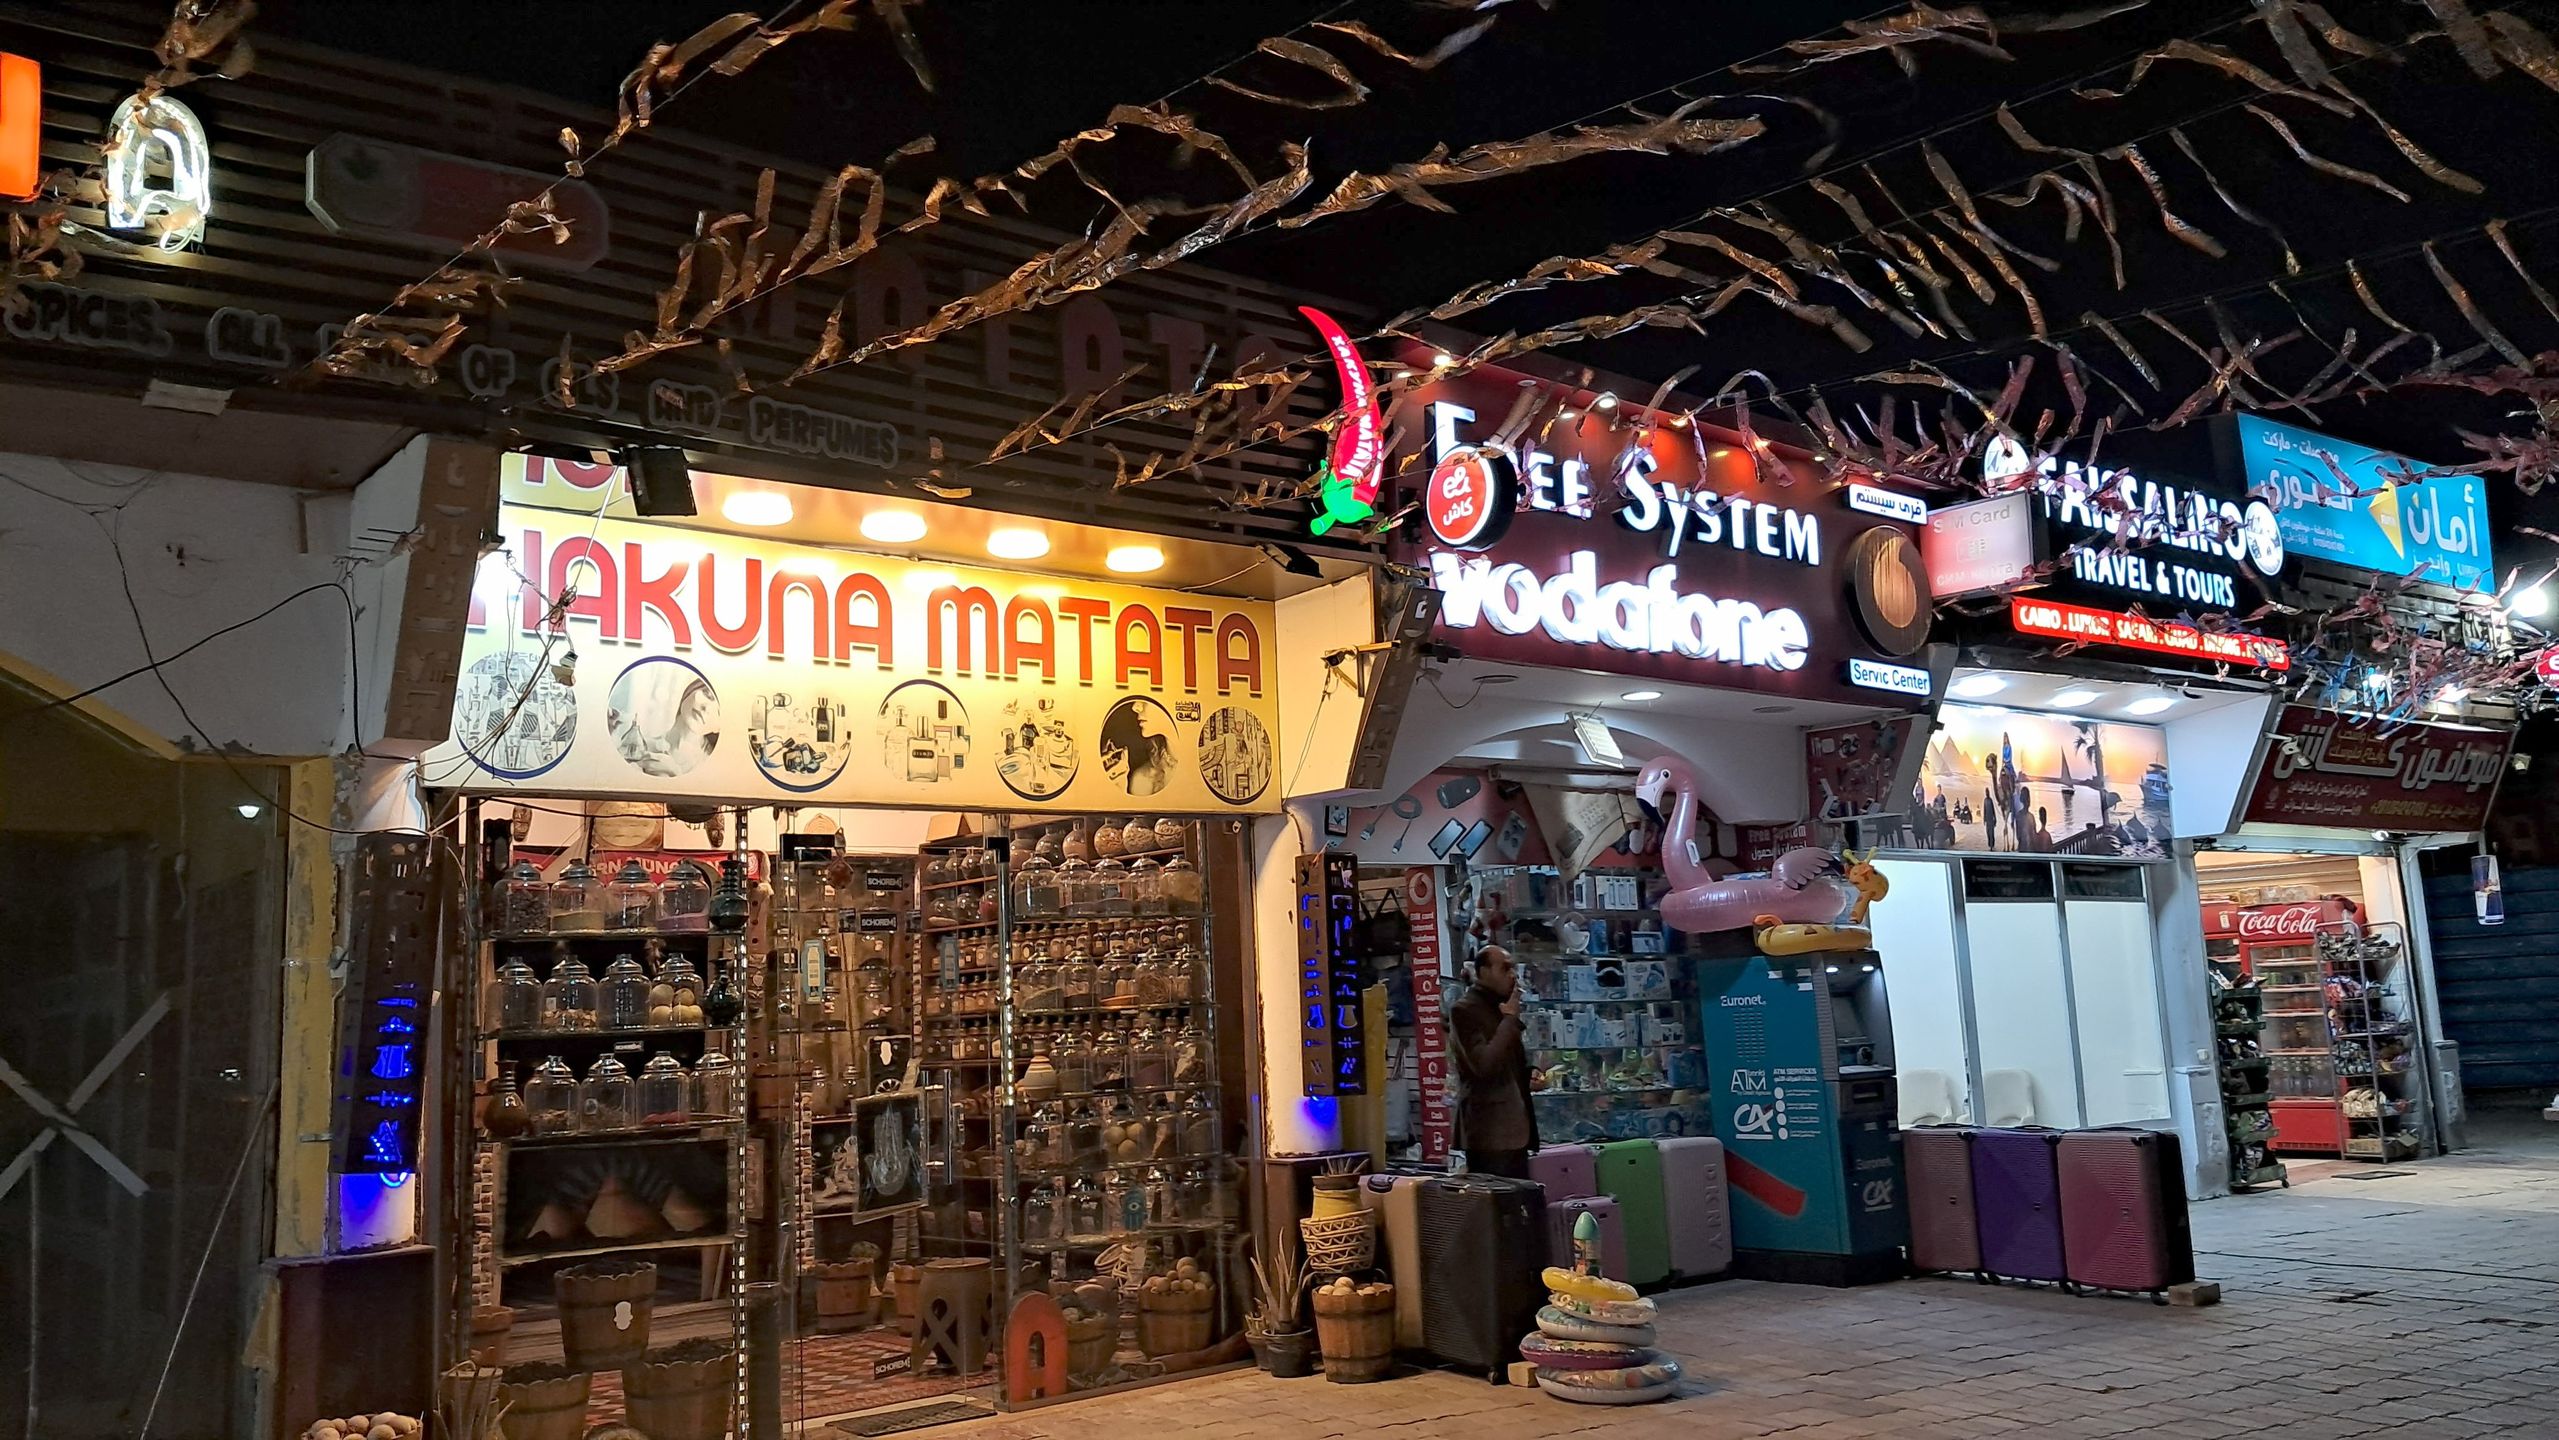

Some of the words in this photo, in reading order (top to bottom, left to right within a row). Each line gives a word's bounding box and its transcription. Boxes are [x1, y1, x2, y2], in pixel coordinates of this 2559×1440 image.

[754, 400, 894, 464] PERFUMES
[1933, 514, 1964, 534] SM
[1970, 504, 2010, 525] Card
[2070, 543, 2152, 592] TRAVEL
[2156, 562, 2171, 594] &
[2174, 565, 2236, 608] TOURS
[1430, 550, 1810, 672] Vodafone
[2020, 605, 2061, 629] CAIRO
[927, 588, 1262, 693] MATATA
[1853, 663, 1889, 685] Servic
[1892, 670, 1927, 690] Center
[2238, 906, 2321, 936] Coca-Cola
[1720, 995, 1763, 1007] Euronet
